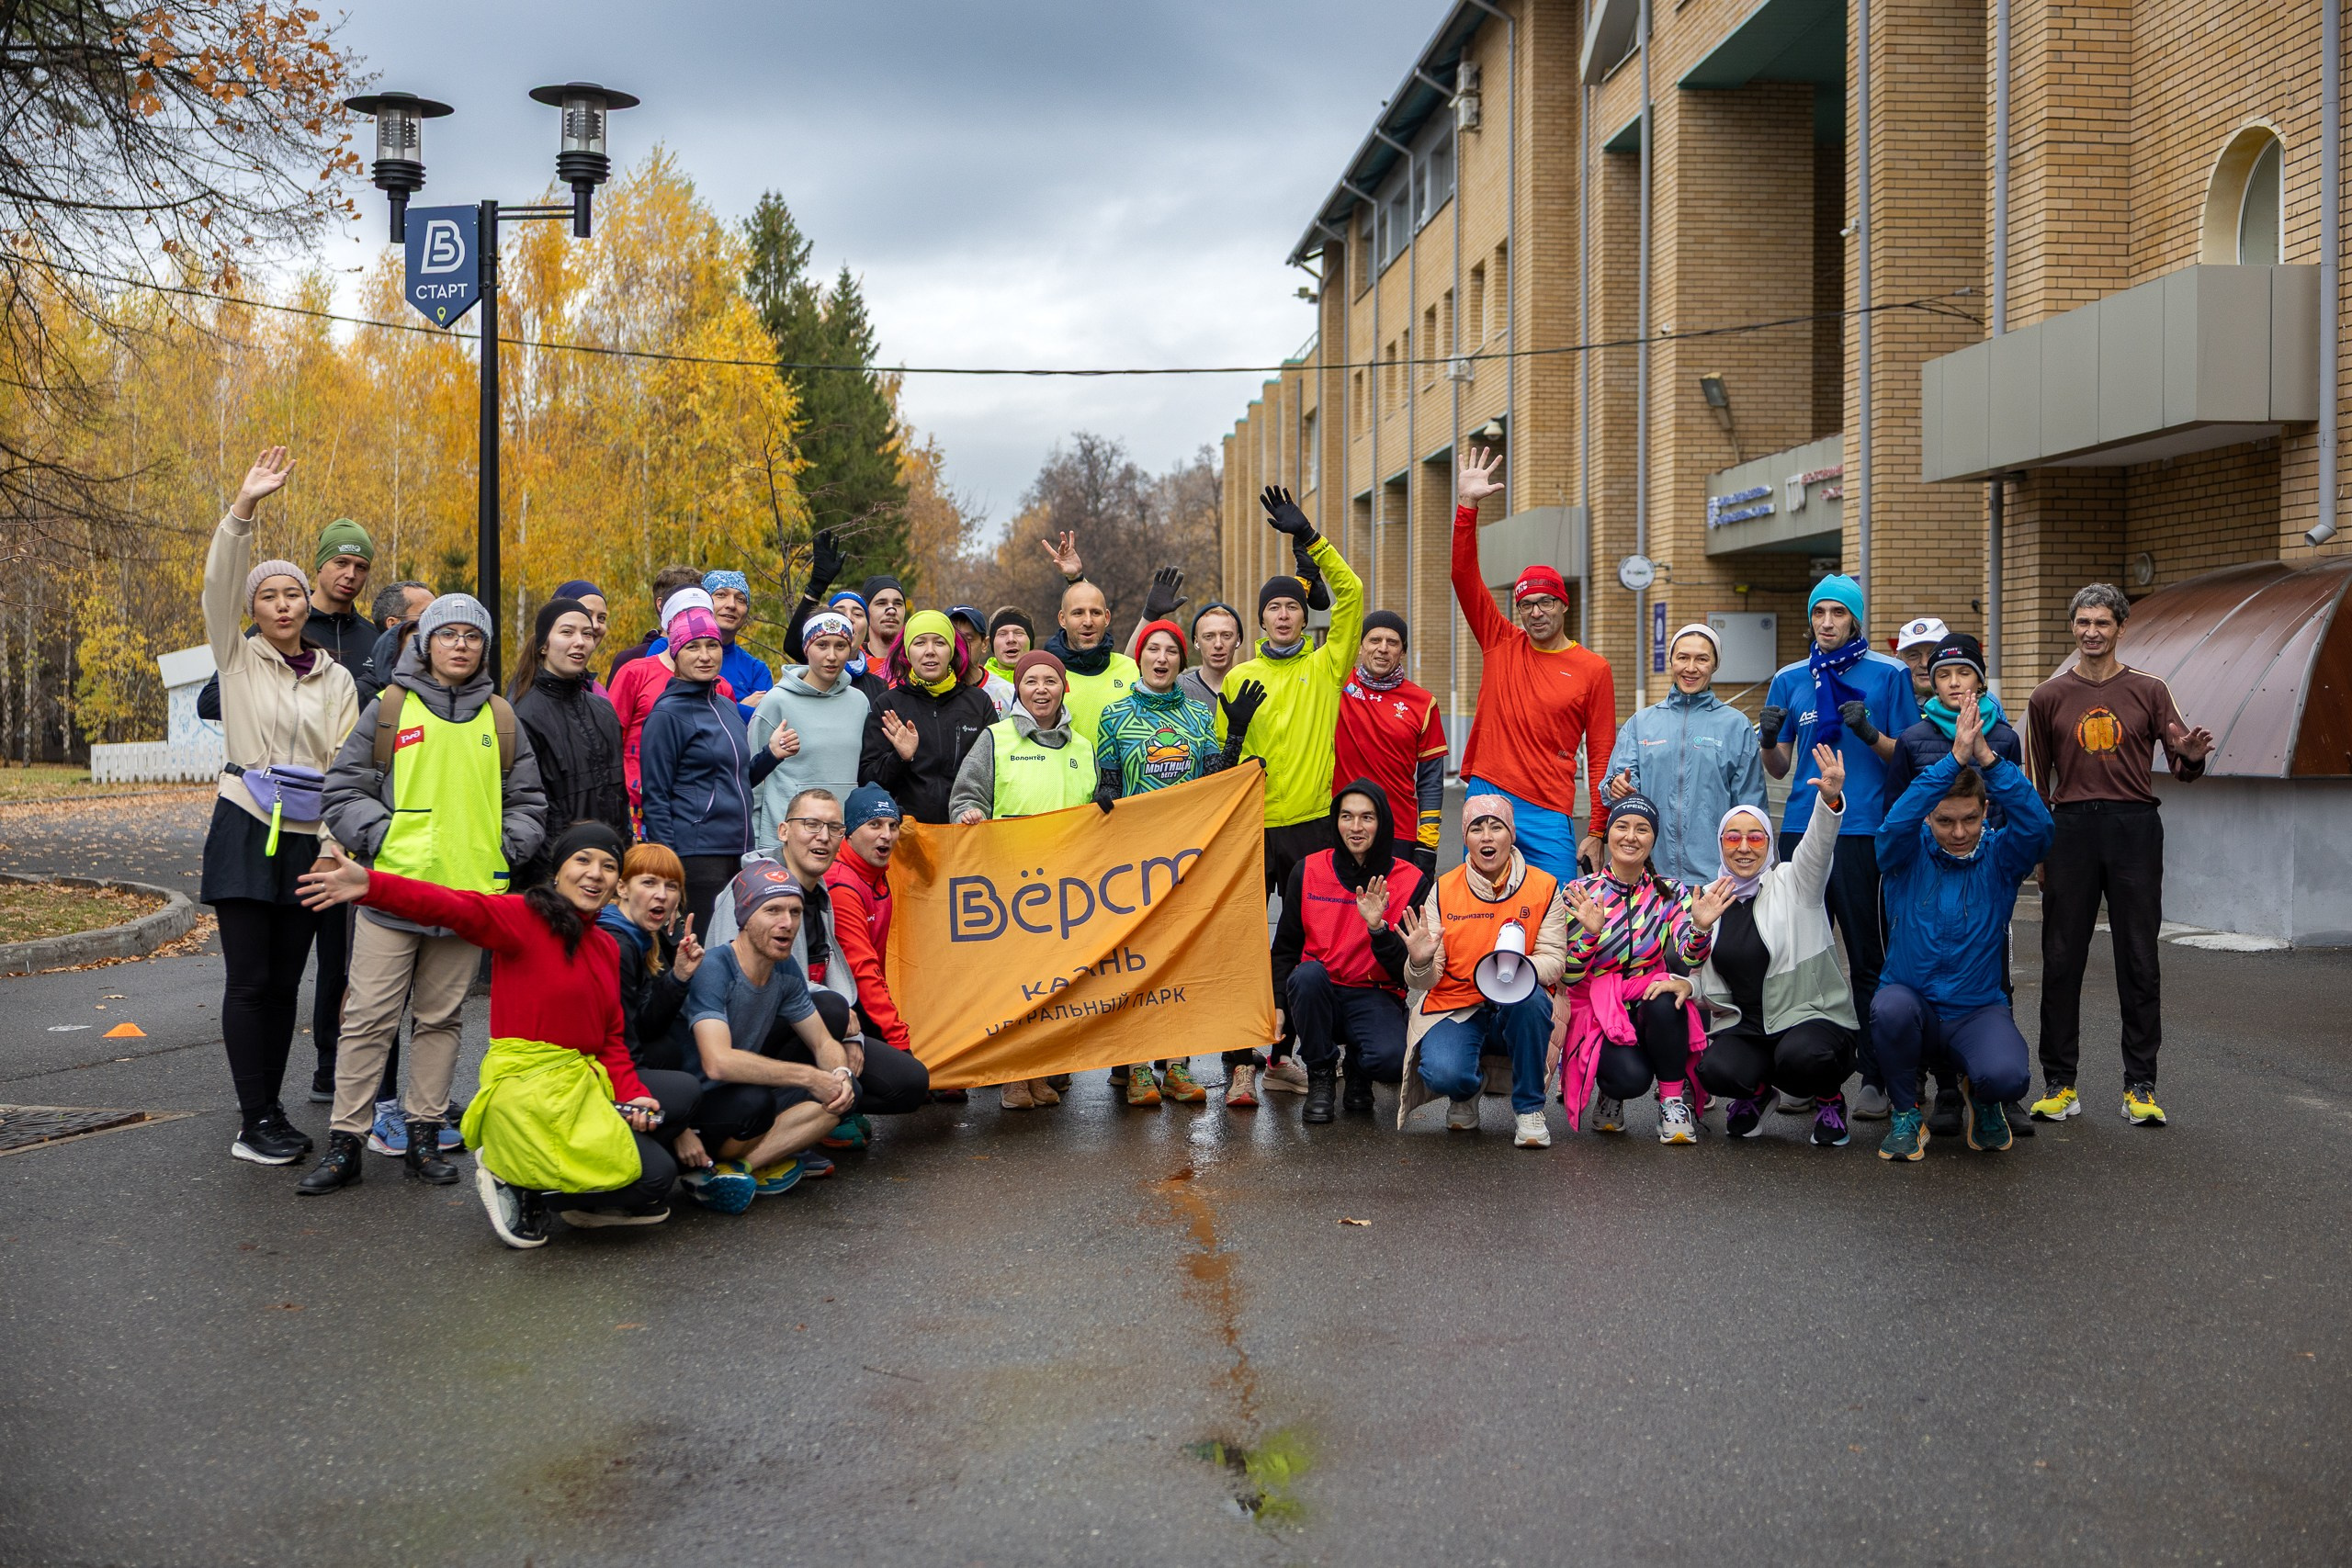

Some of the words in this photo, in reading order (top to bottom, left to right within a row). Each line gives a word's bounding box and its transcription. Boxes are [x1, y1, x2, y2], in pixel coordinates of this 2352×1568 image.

[415, 283, 469, 299] СТАРТ
[1145, 760, 1192, 773] МЫТИЩИ
[1623, 804, 1648, 812] ТРЕЙЛ
[1446, 912, 1495, 921] Организатор
[1133, 987, 1187, 1009] ПАРК
